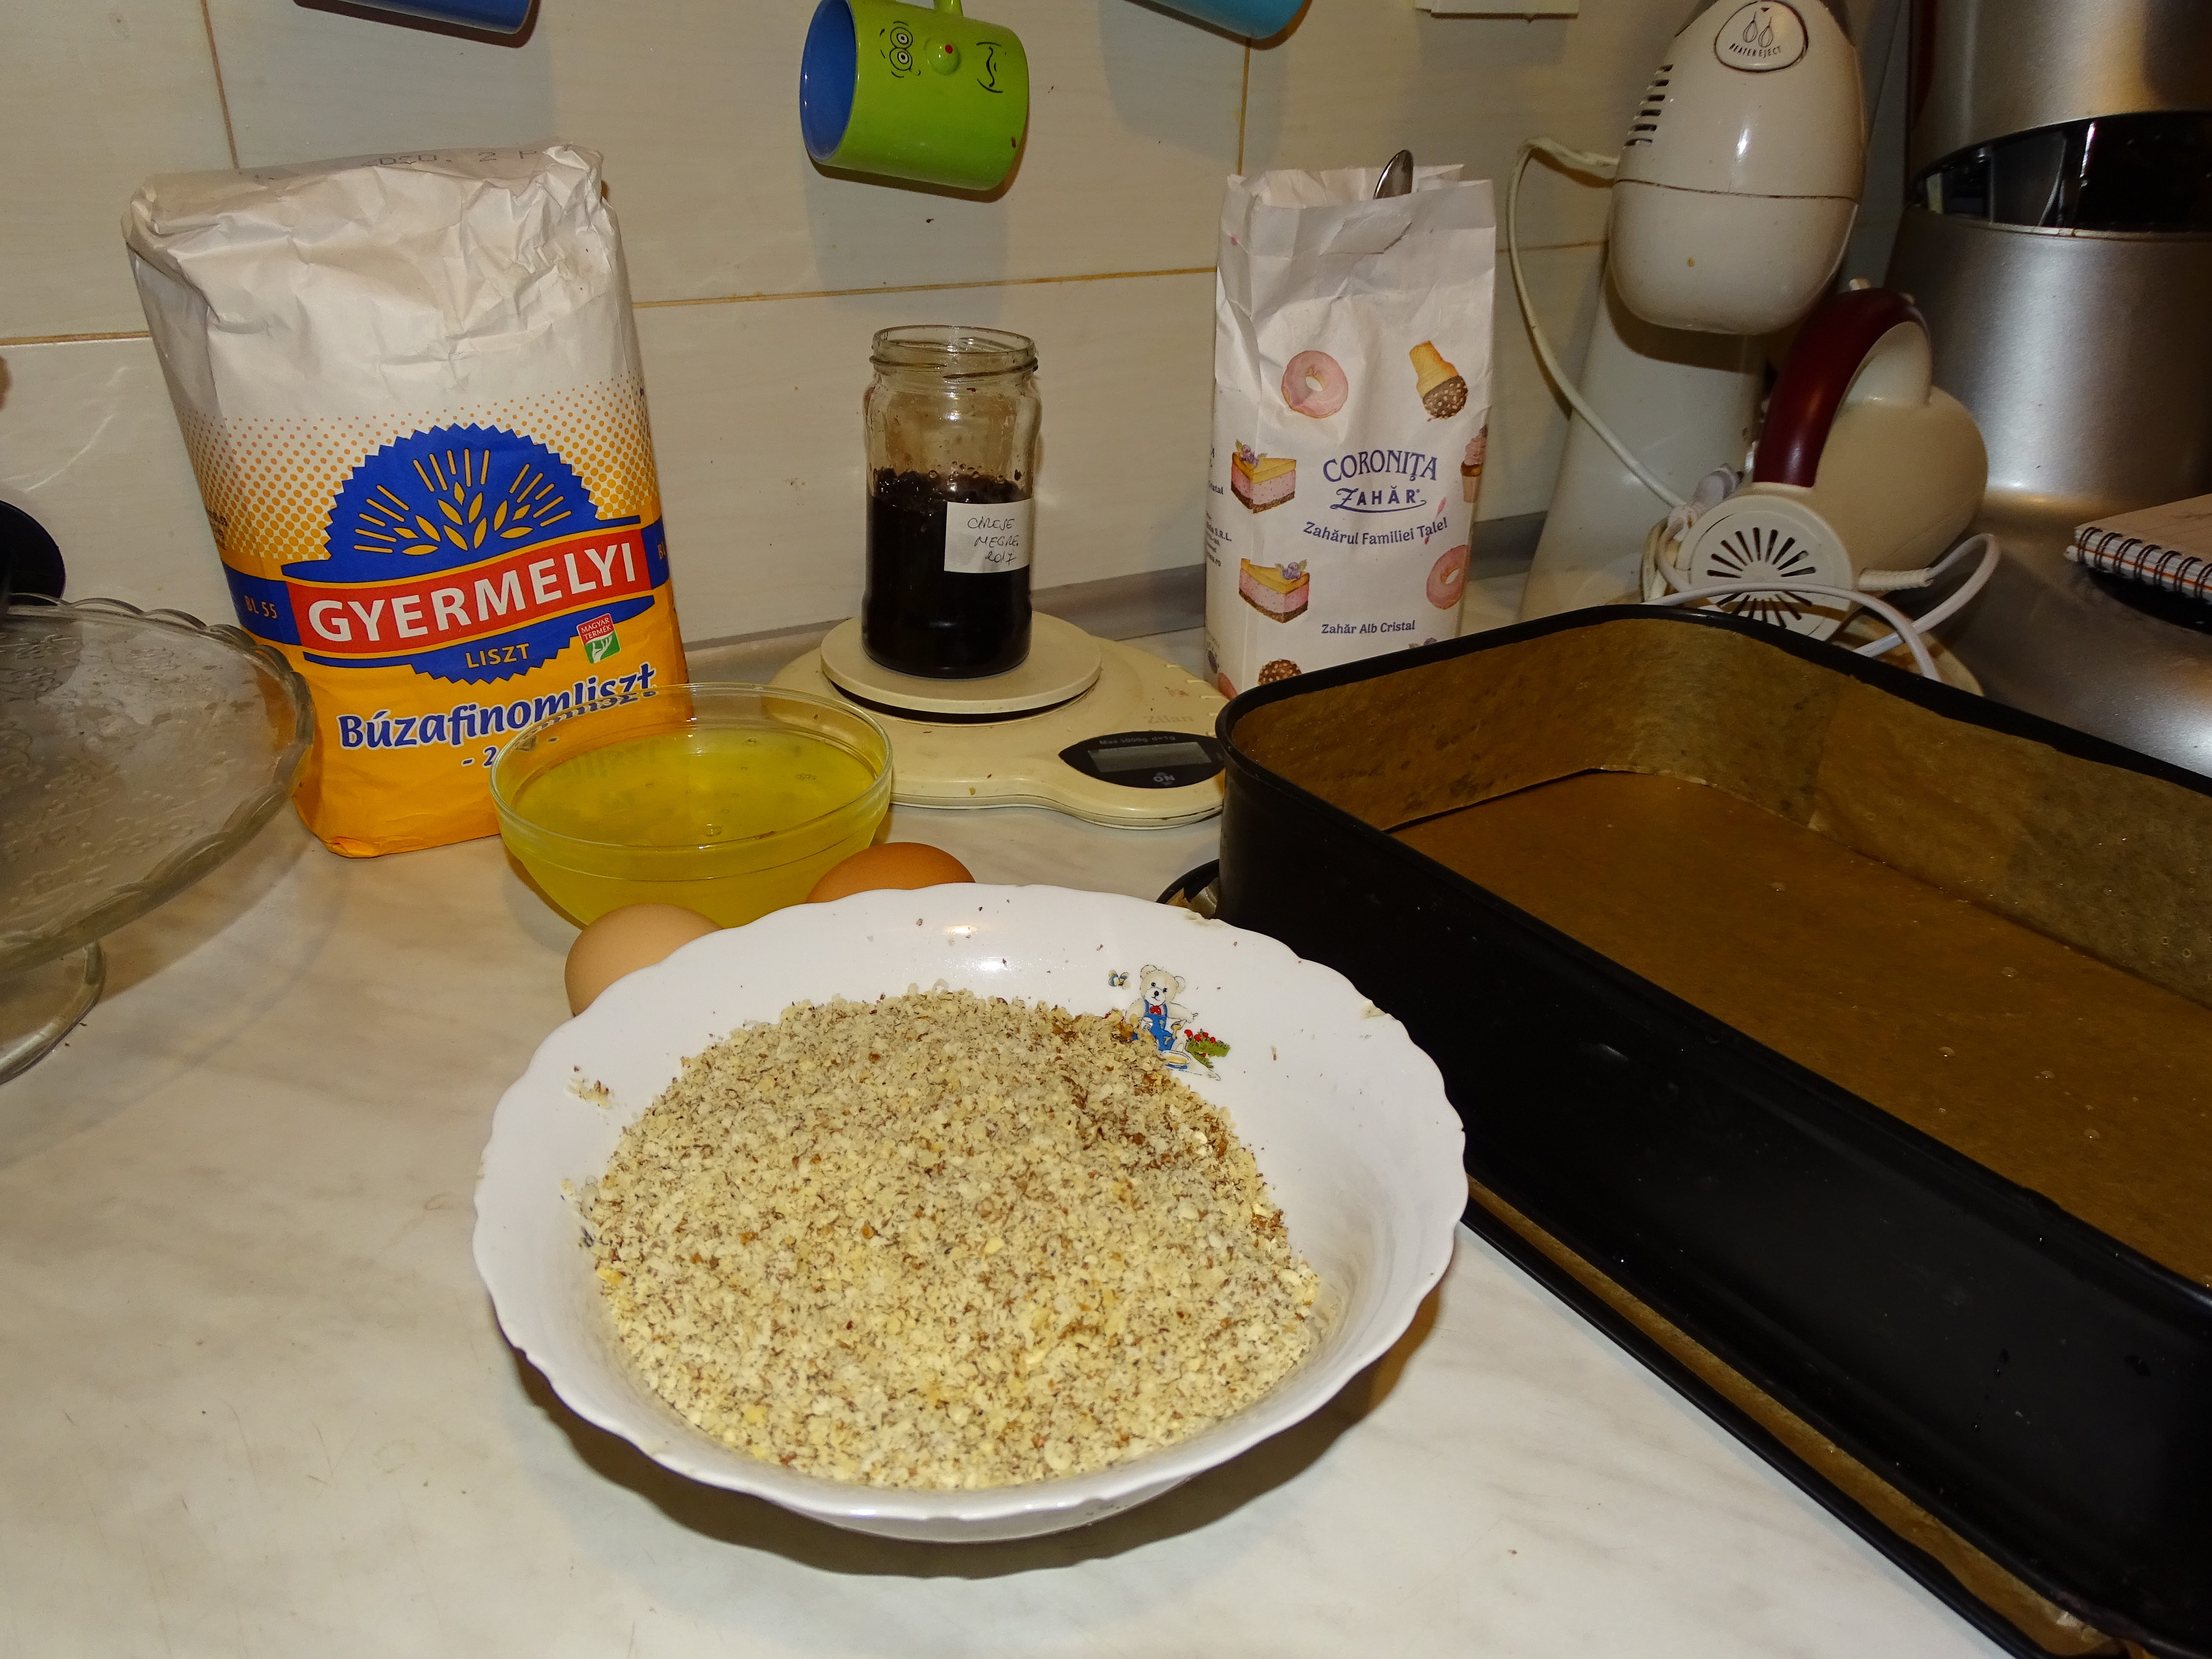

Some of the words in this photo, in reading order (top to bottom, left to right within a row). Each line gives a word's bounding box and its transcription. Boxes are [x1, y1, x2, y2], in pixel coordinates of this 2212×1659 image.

[1728, 43, 1756, 57] BEATER
[1758, 45, 1781, 58] EJECT
[1214, 527, 1232, 541] S.R.L.
[1303, 521, 1358, 545] Zahărul
[1362, 528, 1415, 545] Familiei
[1417, 517, 1448, 538] Tale!
[985, 550, 1016, 566] 2017
[308, 542, 635, 642] GYERMELYI
[244, 595, 259, 614] BL
[261, 601, 277, 619] 55
[581, 617, 610, 634] MAGYAR
[583, 624, 611, 640] TERMÉK
[1321, 623, 1357, 634] Zahăr
[1359, 623, 1377, 634] Alb
[1380, 620, 1415, 633] Cristal
[465, 643, 530, 669] LISZT
[337, 663, 656, 748] Búzafinomliszt
[1153, 774, 1175, 783] ON
